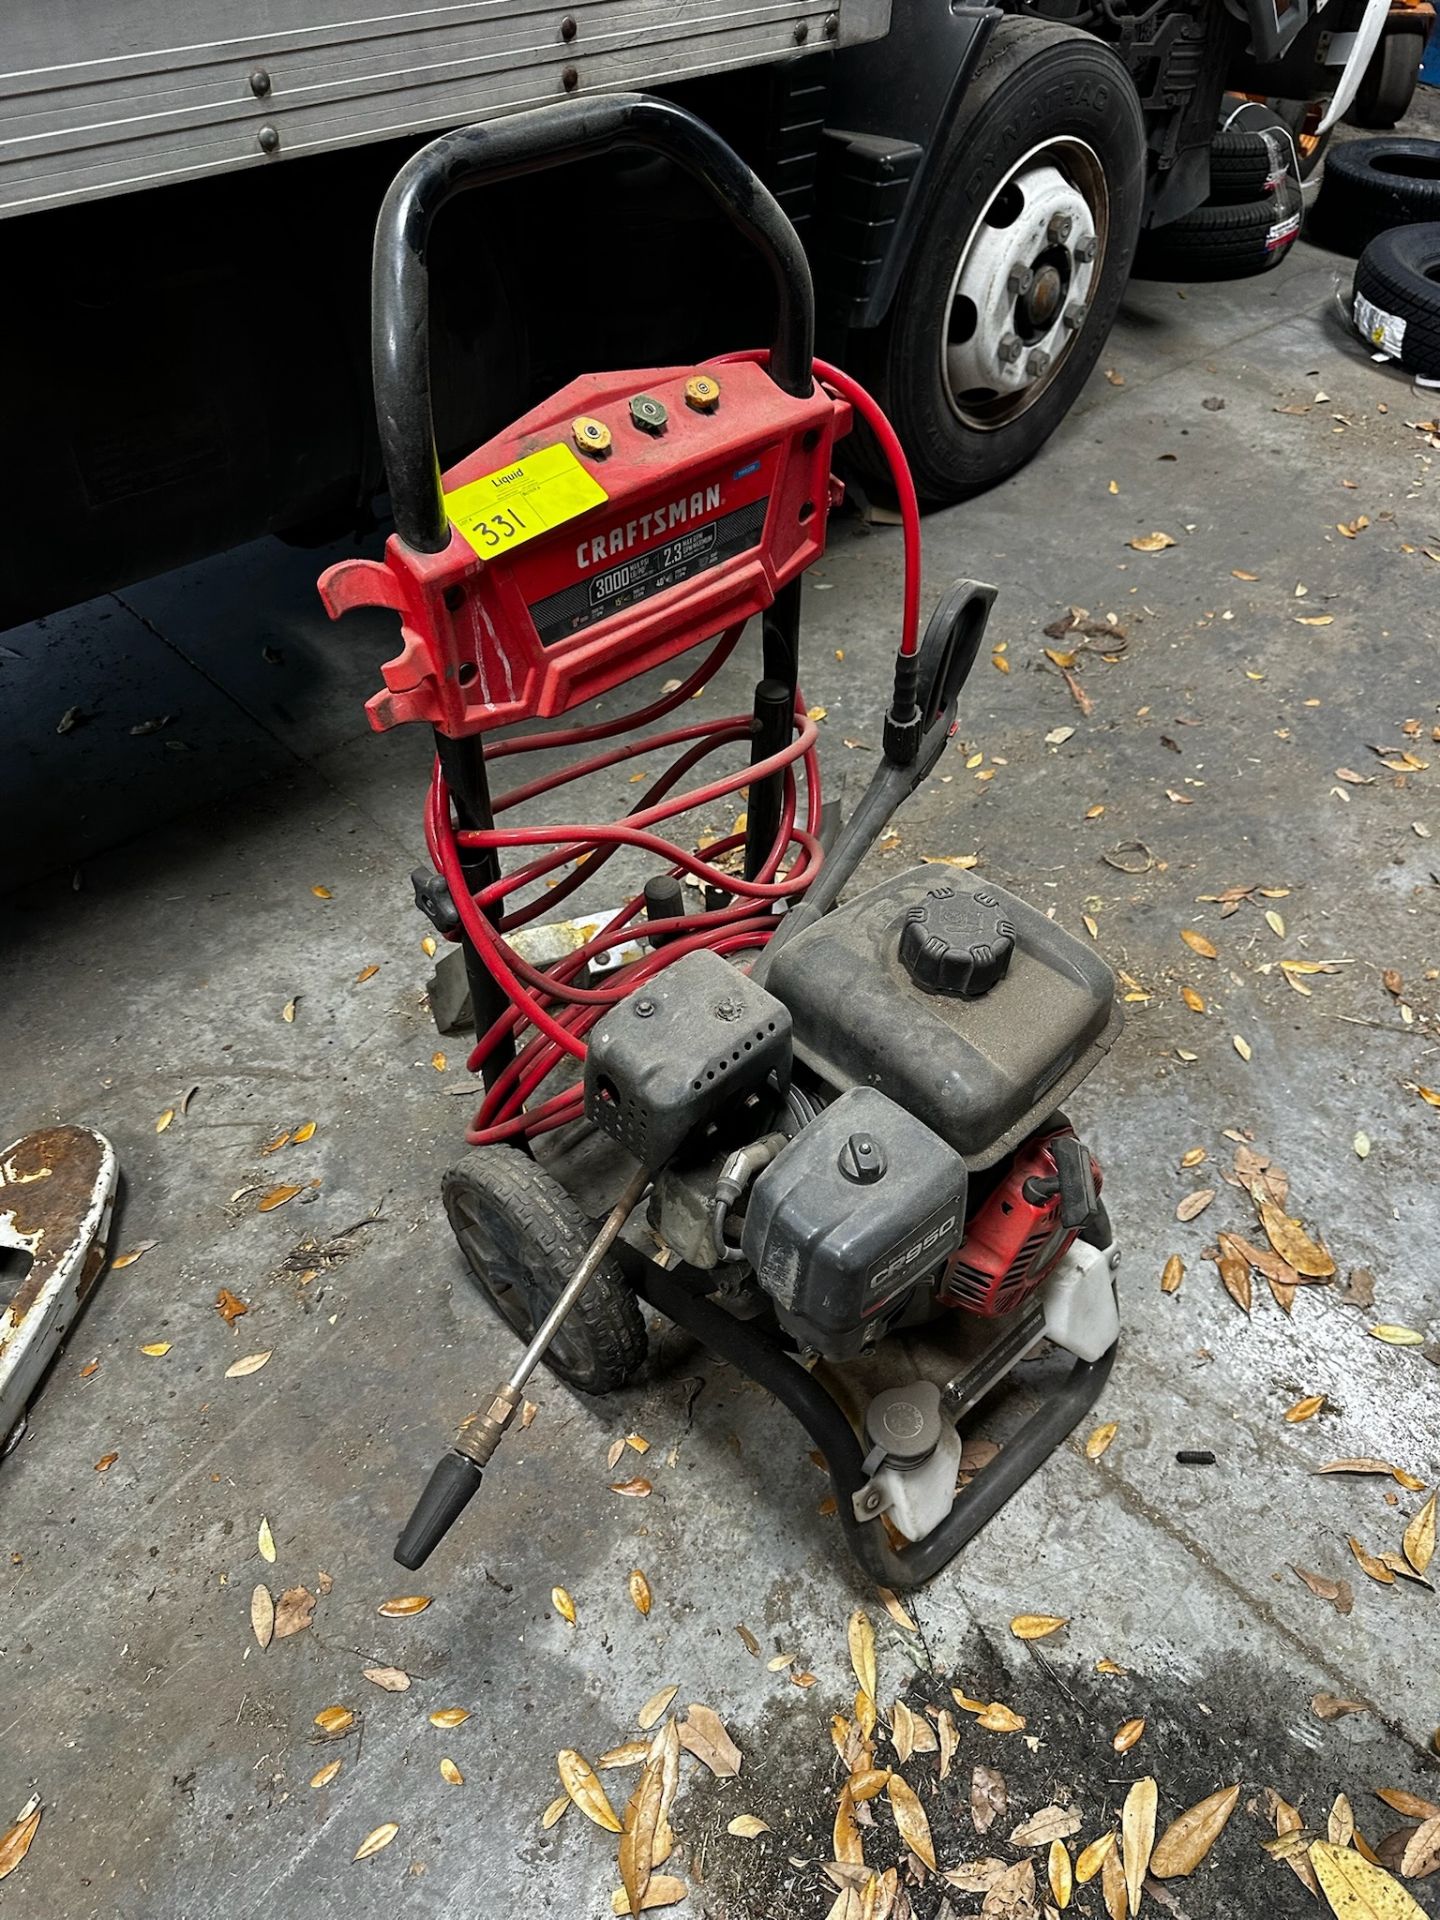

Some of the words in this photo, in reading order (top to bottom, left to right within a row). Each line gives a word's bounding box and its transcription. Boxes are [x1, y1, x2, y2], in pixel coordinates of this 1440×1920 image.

[491, 468, 524, 487] Liquid
[472, 508, 527, 547] 331
[576, 483, 721, 569] CRAFTSMAN
[664, 543, 682, 566] 2.3
[596, 568, 630, 598] 3000
[869, 1215, 956, 1289] CR950
